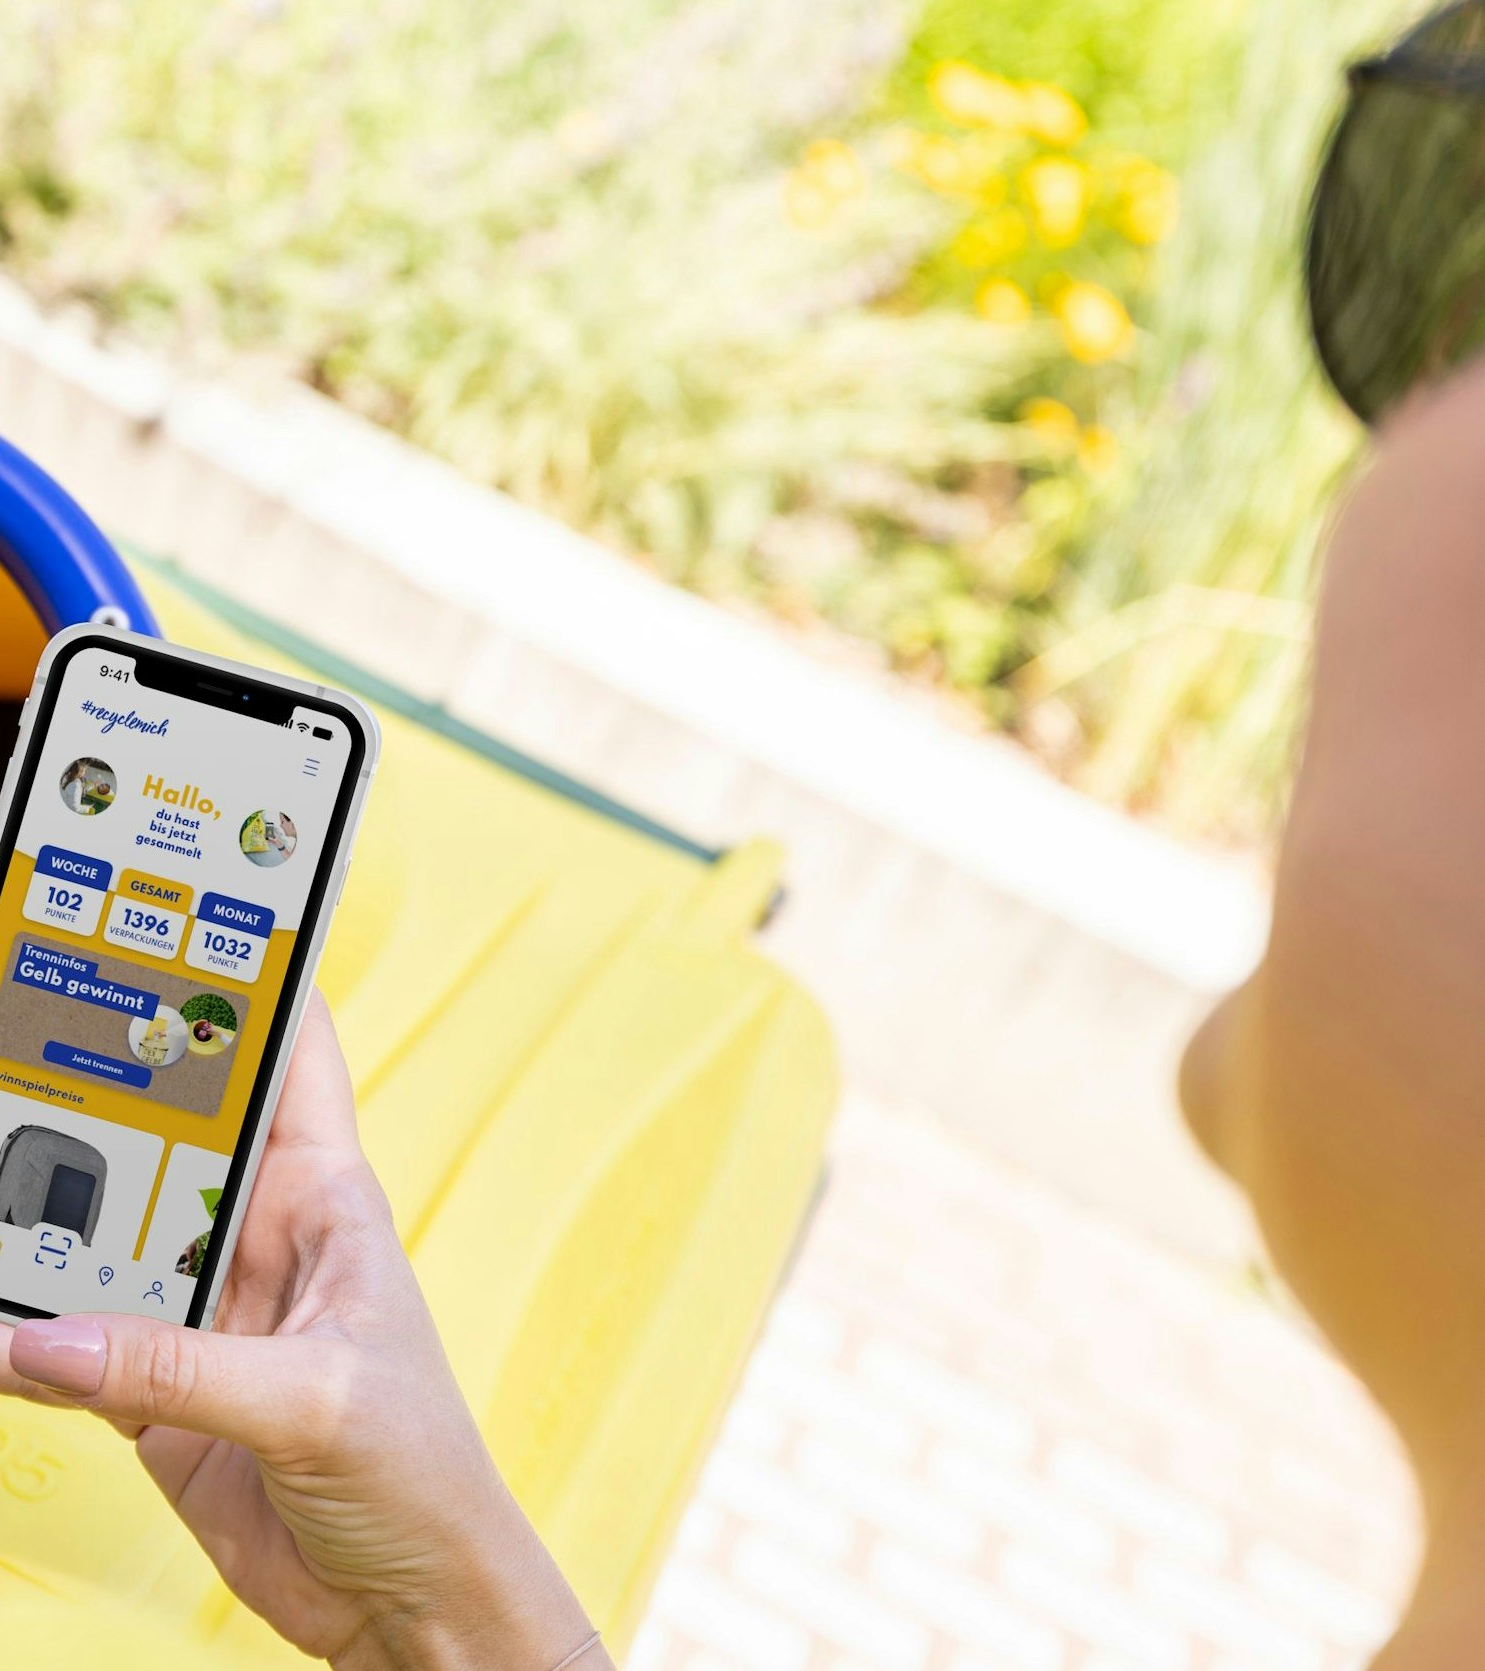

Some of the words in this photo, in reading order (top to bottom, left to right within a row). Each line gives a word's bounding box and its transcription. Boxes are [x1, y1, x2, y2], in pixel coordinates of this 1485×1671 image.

[99, 665, 130, 683] 9:41
[81, 700, 169, 738] #recyclemich
[142, 774, 221, 821] Hallo,
[156, 808, 172, 822] du
[174, 811, 200, 830] hast
[150, 821, 166, 835] bis
[167, 825, 196, 844] jetzt
[135, 832, 202, 860] gesammelt
[51, 857, 98, 880] WOCHE
[47, 886, 83, 912] 102
[130, 881, 182, 903] GESAMT
[45, 907, 76, 923] PUNKTE
[122, 908, 169, 936] 1396
[213, 903, 261, 927] MONAT
[109, 926, 175, 953] VERPACKUNGEN
[203, 931, 252, 961] 1032
[24, 945, 87, 973] Trenninfos
[207, 954, 239, 970] PUNKTE
[19, 961, 63, 987] Gelb
[66, 974, 145, 1011] gewinnt
[72, 1053, 92, 1068] Jetzt
[92, 1059, 123, 1075] trennen
